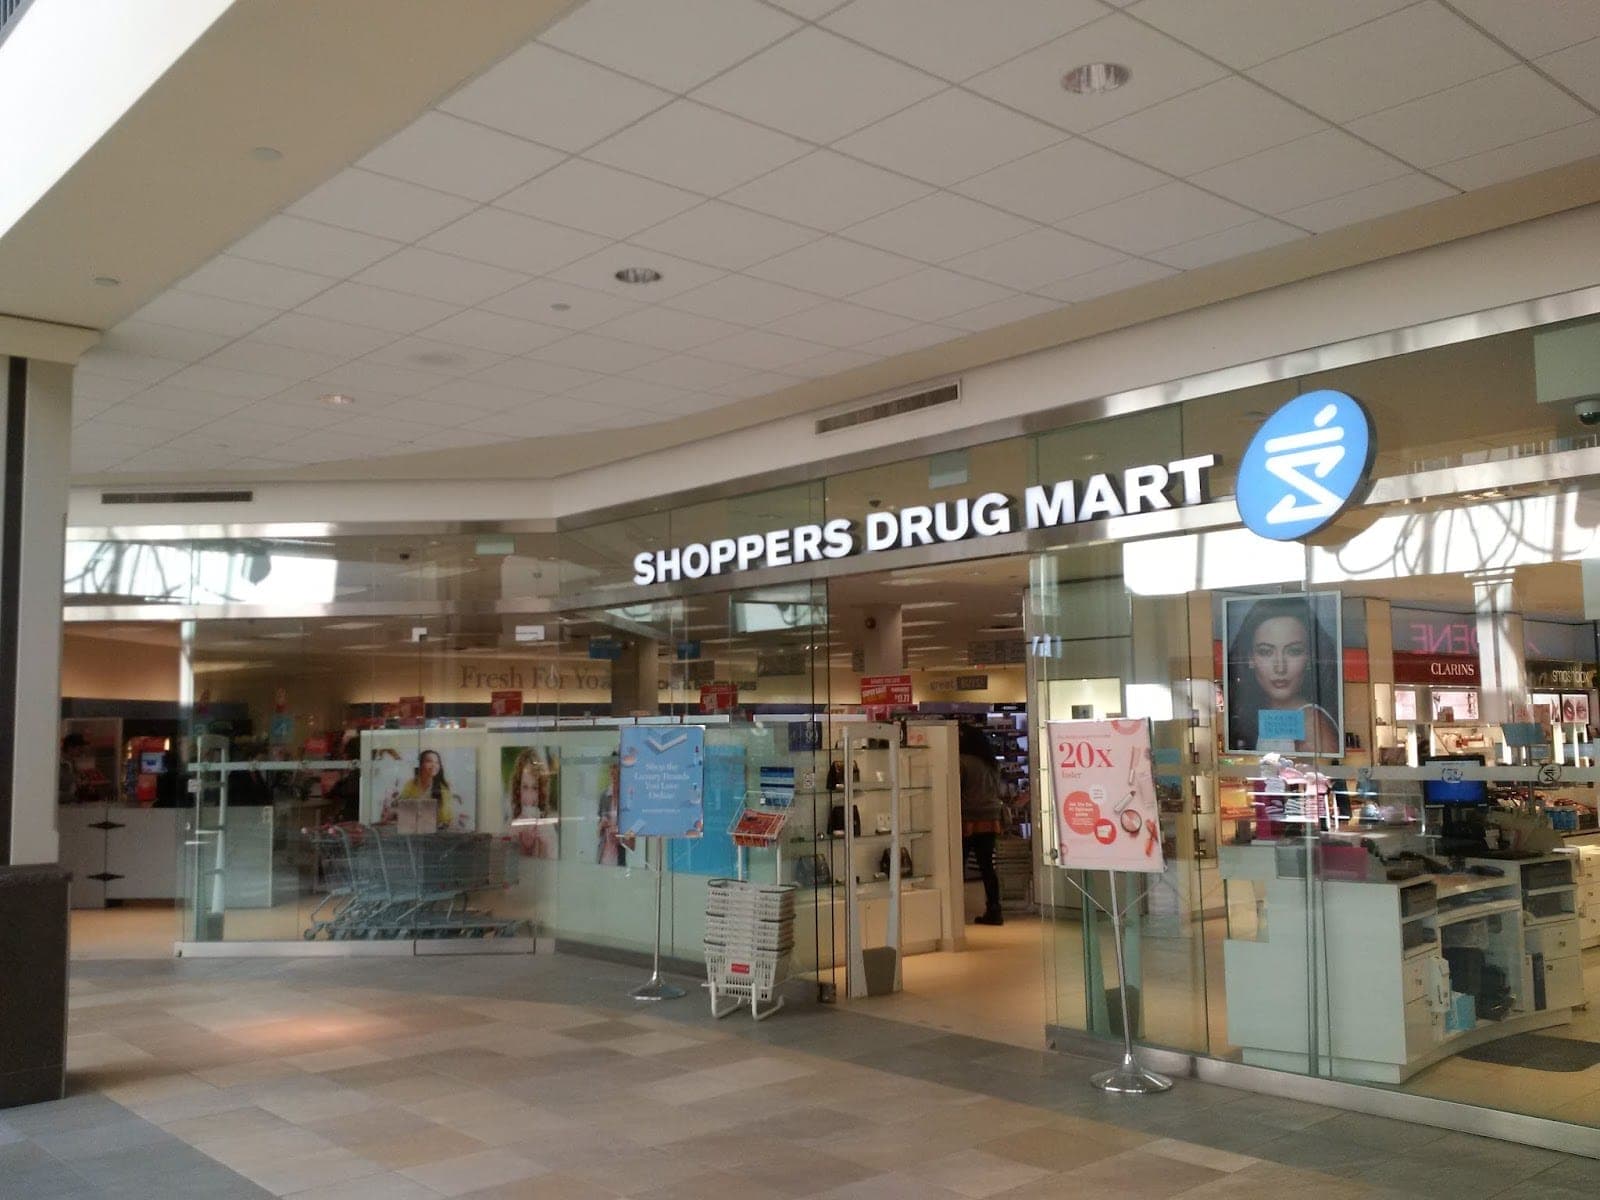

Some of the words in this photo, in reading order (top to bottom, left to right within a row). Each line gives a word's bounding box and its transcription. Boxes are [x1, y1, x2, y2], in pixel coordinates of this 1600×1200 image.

[633, 518, 853, 586] SHOPPERS
[866, 493, 1011, 551] DRUG
[1025, 454, 1215, 530] MART
[459, 665, 524, 689] Fresh
[532, 667, 566, 690] For
[1430, 662, 1475, 676] CLARINS
[1058, 741, 1115, 769] 20x
